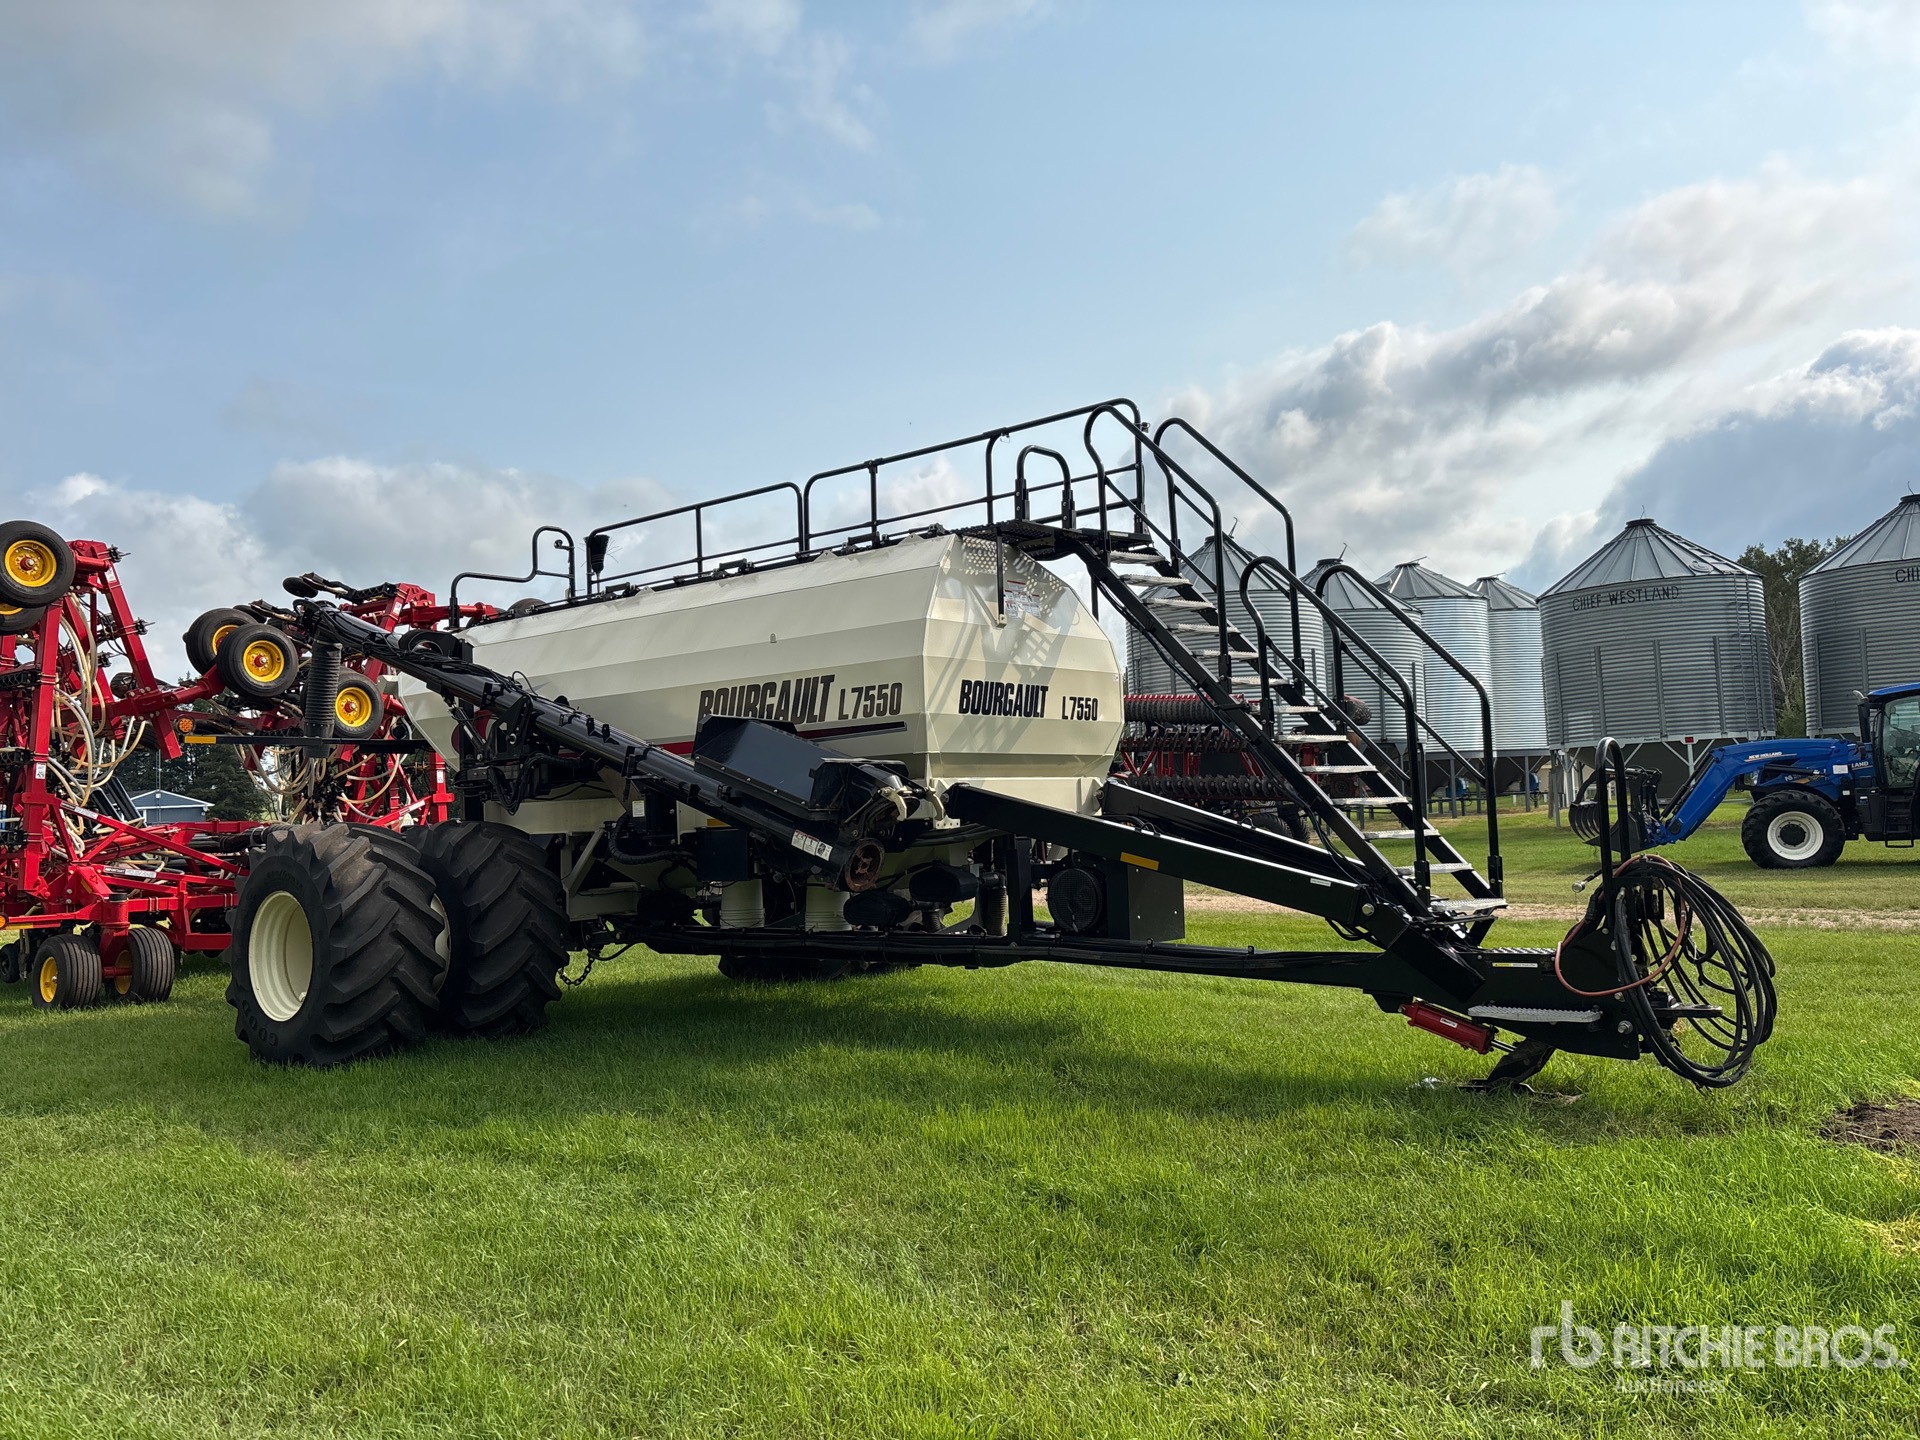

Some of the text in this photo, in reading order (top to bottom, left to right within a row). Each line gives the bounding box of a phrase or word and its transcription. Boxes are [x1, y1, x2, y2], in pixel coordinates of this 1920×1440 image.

[1895, 568, 1920, 583] CHI
[1572, 585, 1680, 611] CHIEF WESTLAND
[698, 674, 903, 724] BOURGAULT L7550
[958, 679, 1098, 721] BOURGAULT L7550
